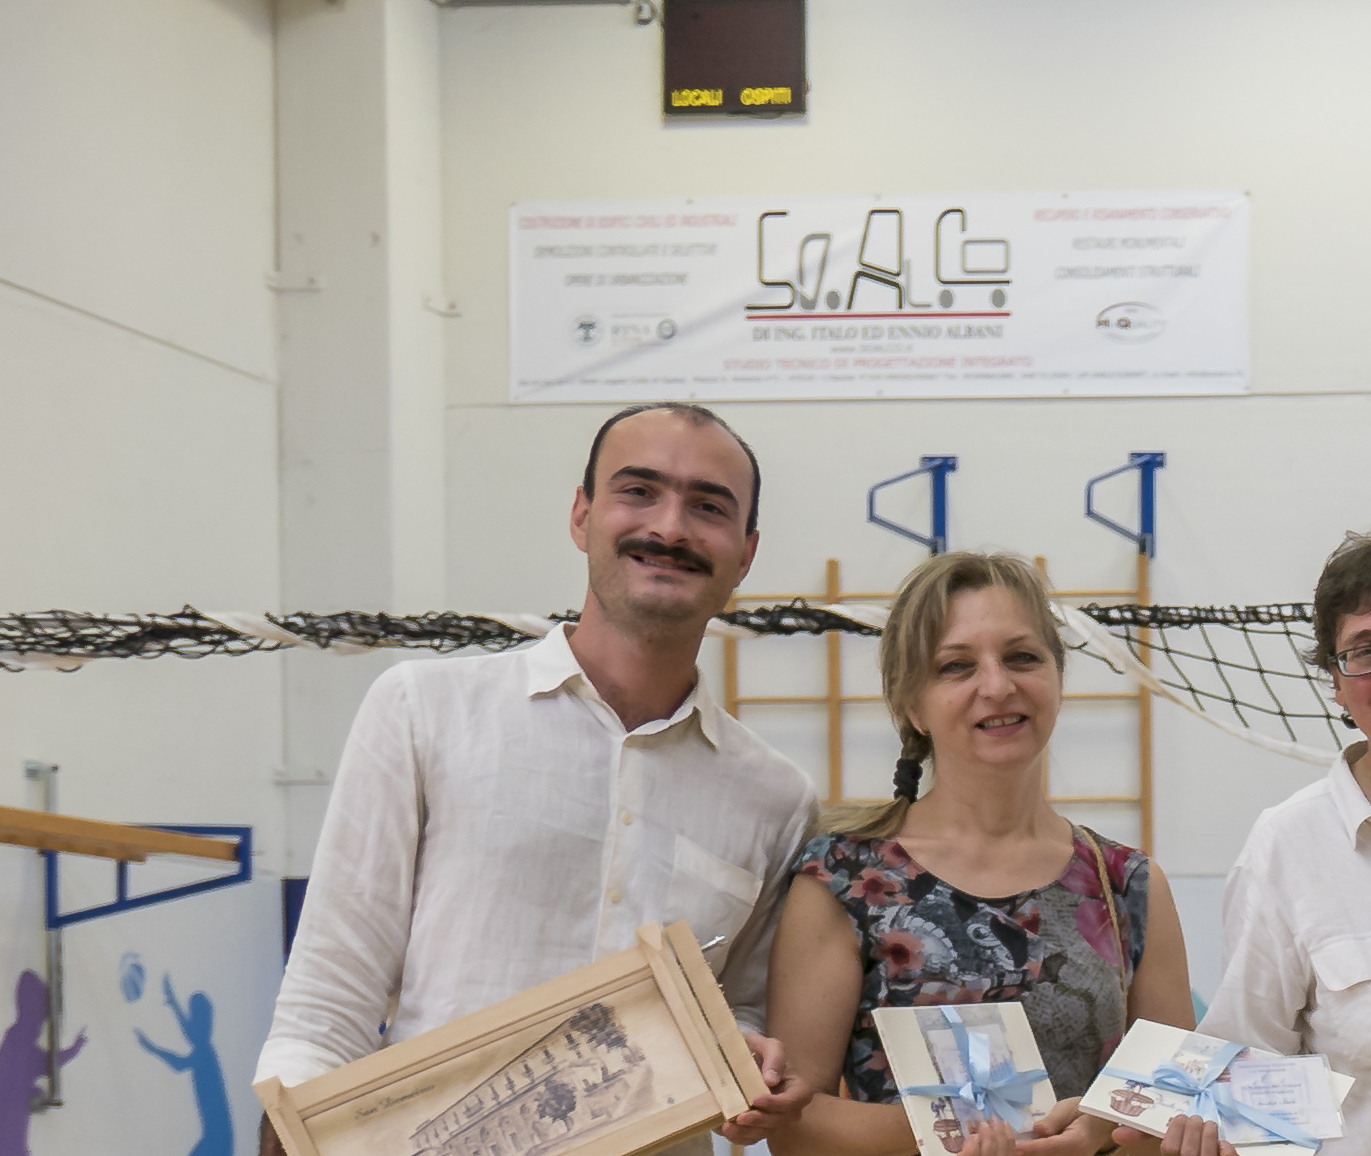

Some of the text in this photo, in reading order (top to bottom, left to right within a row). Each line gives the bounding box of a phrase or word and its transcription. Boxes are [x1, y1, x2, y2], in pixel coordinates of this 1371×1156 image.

[811, 325, 858, 341] ITALO
[861, 325, 884, 341] ED
[887, 324, 942, 341] ENNIO
